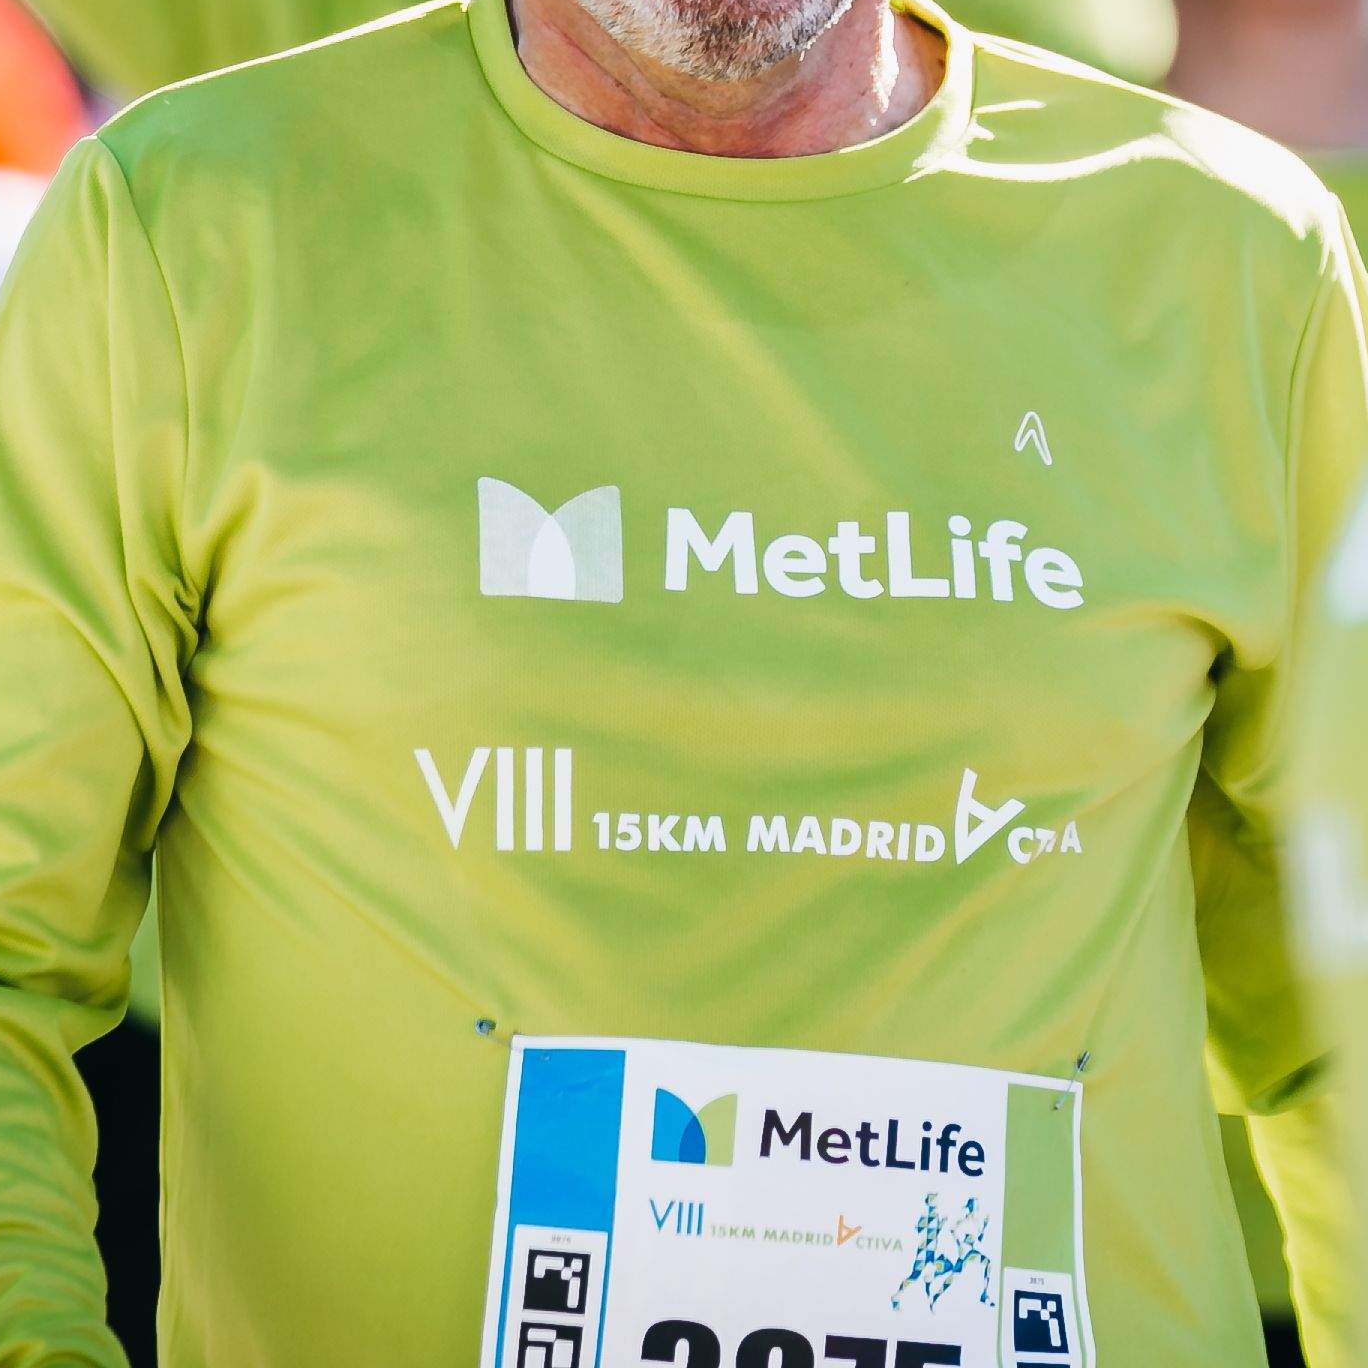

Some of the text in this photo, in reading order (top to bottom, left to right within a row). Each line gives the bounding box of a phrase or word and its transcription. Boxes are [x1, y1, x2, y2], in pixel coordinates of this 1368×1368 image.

[664, 507, 1084, 609] MetLife
[414, 746, 572, 851] VIII
[592, 812, 727, 853] 15KM
[759, 1109, 985, 1177] MetLife
[649, 1197, 704, 1236] VIII
[710, 1224, 756, 1240] 15KM
